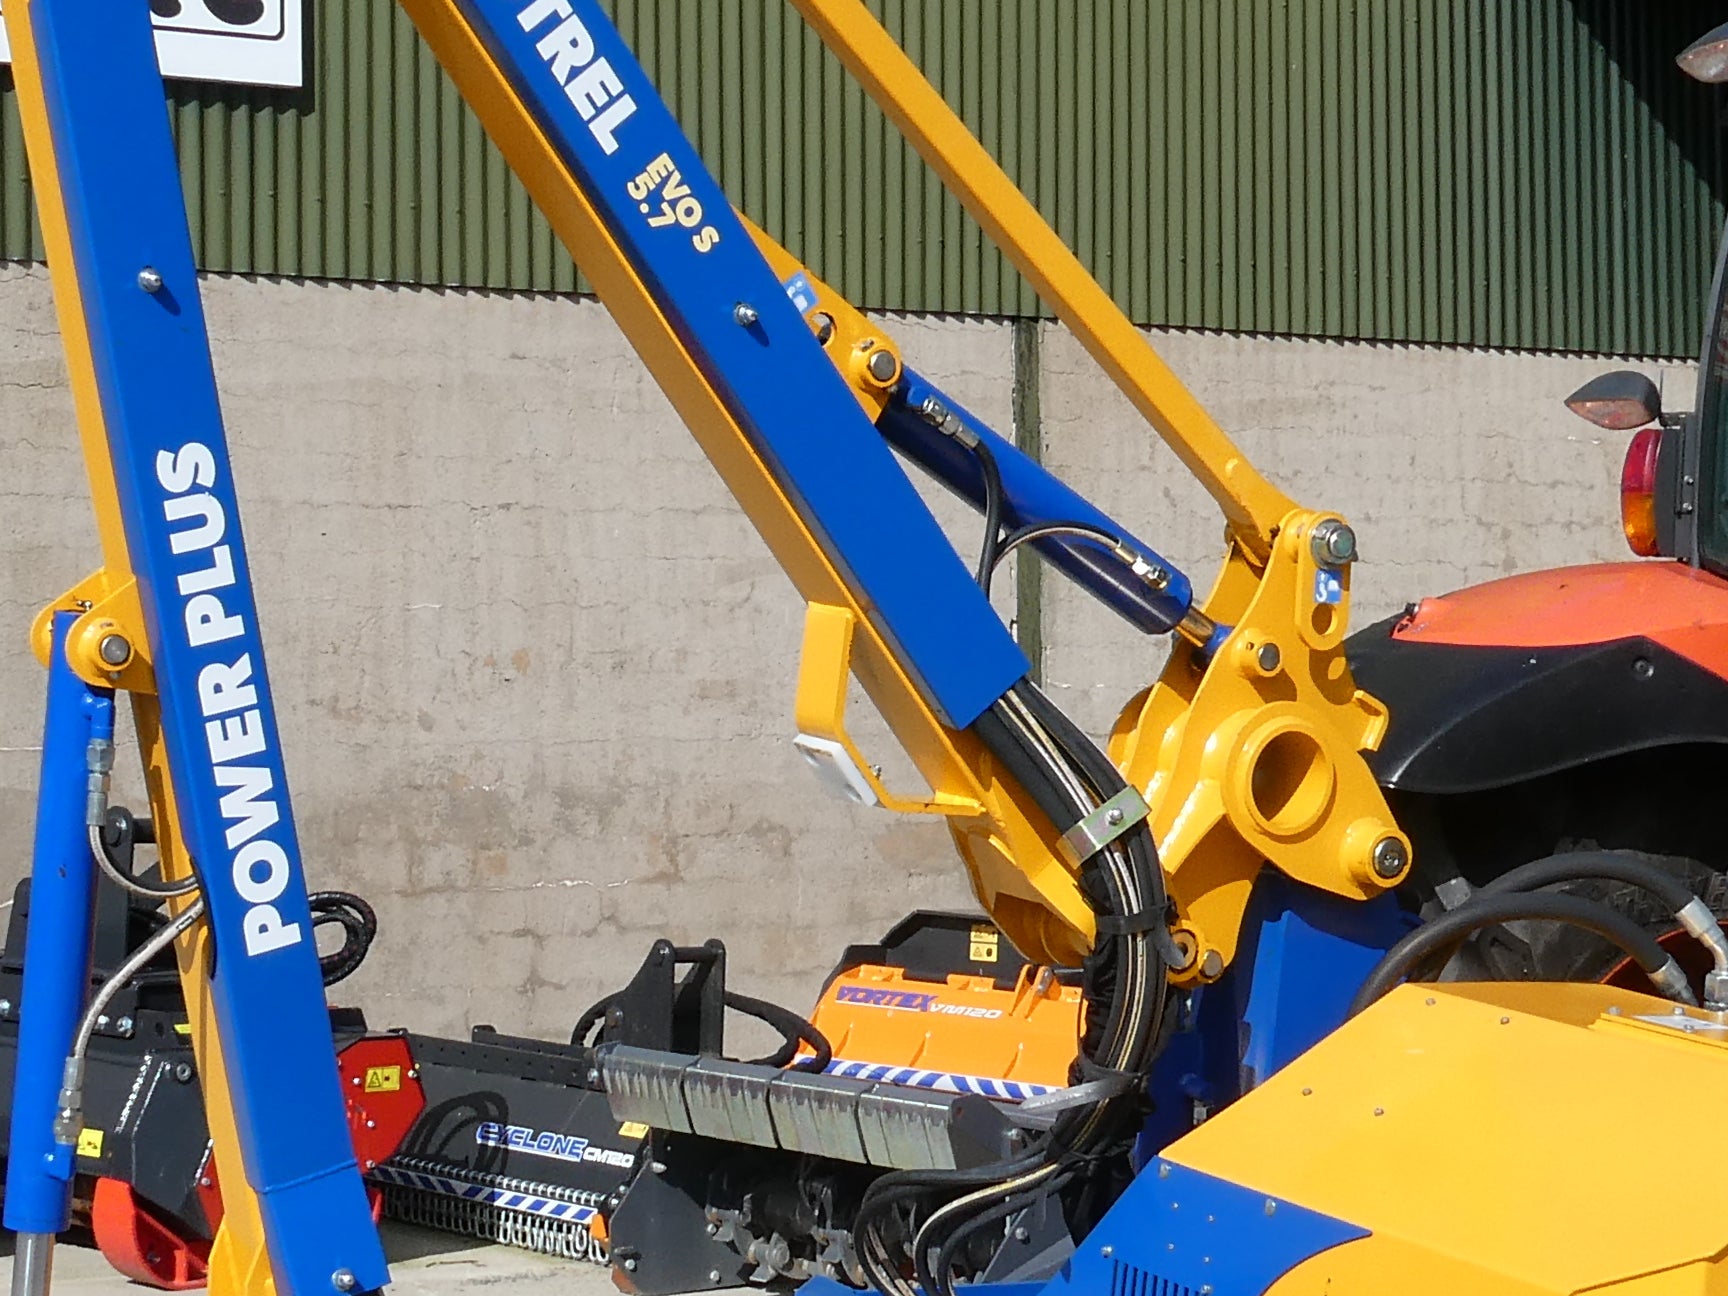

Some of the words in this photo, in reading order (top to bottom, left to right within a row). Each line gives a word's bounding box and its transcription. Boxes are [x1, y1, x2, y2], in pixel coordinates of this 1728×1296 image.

[627, 172, 678, 229] 5.7
[644, 152, 703, 229] EVO
[156, 442, 246, 648] PLUS
[197, 651, 303, 957] POWER
[836, 985, 939, 1012] VORTEX
[930, 1002, 1004, 1019] VM120
[477, 1121, 589, 1161] CYCLONE
[583, 1146, 635, 1168] CM120
